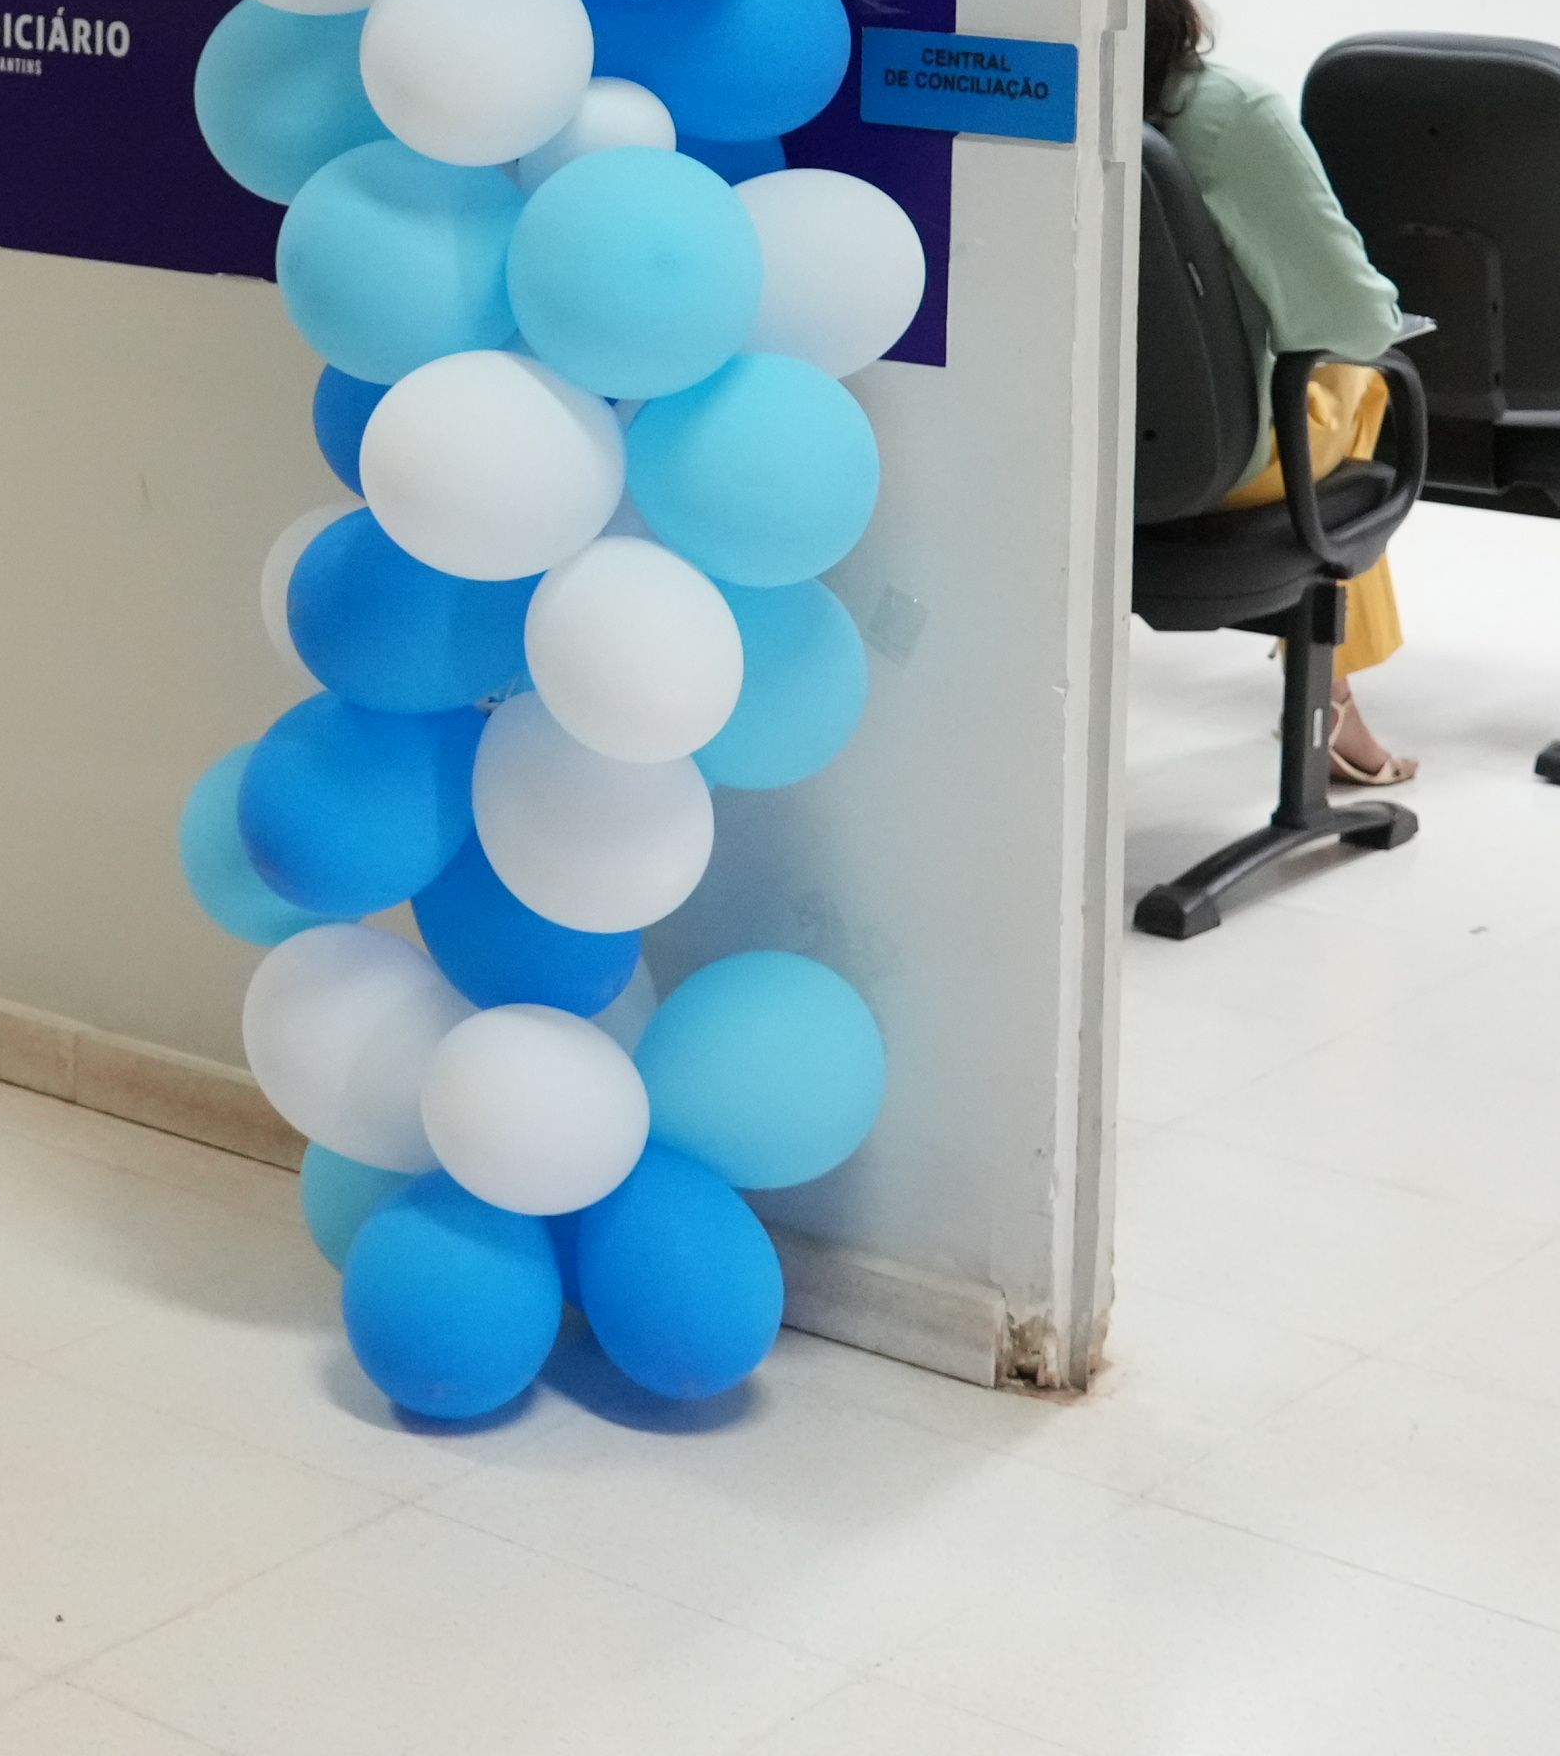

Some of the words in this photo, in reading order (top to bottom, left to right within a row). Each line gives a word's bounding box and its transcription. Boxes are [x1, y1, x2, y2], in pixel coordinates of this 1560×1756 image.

[921, 48, 1012, 71] CENTRAL
[884, 68, 909, 88] DE
[914, 72, 1049, 100] CONCILIAÇÃO
